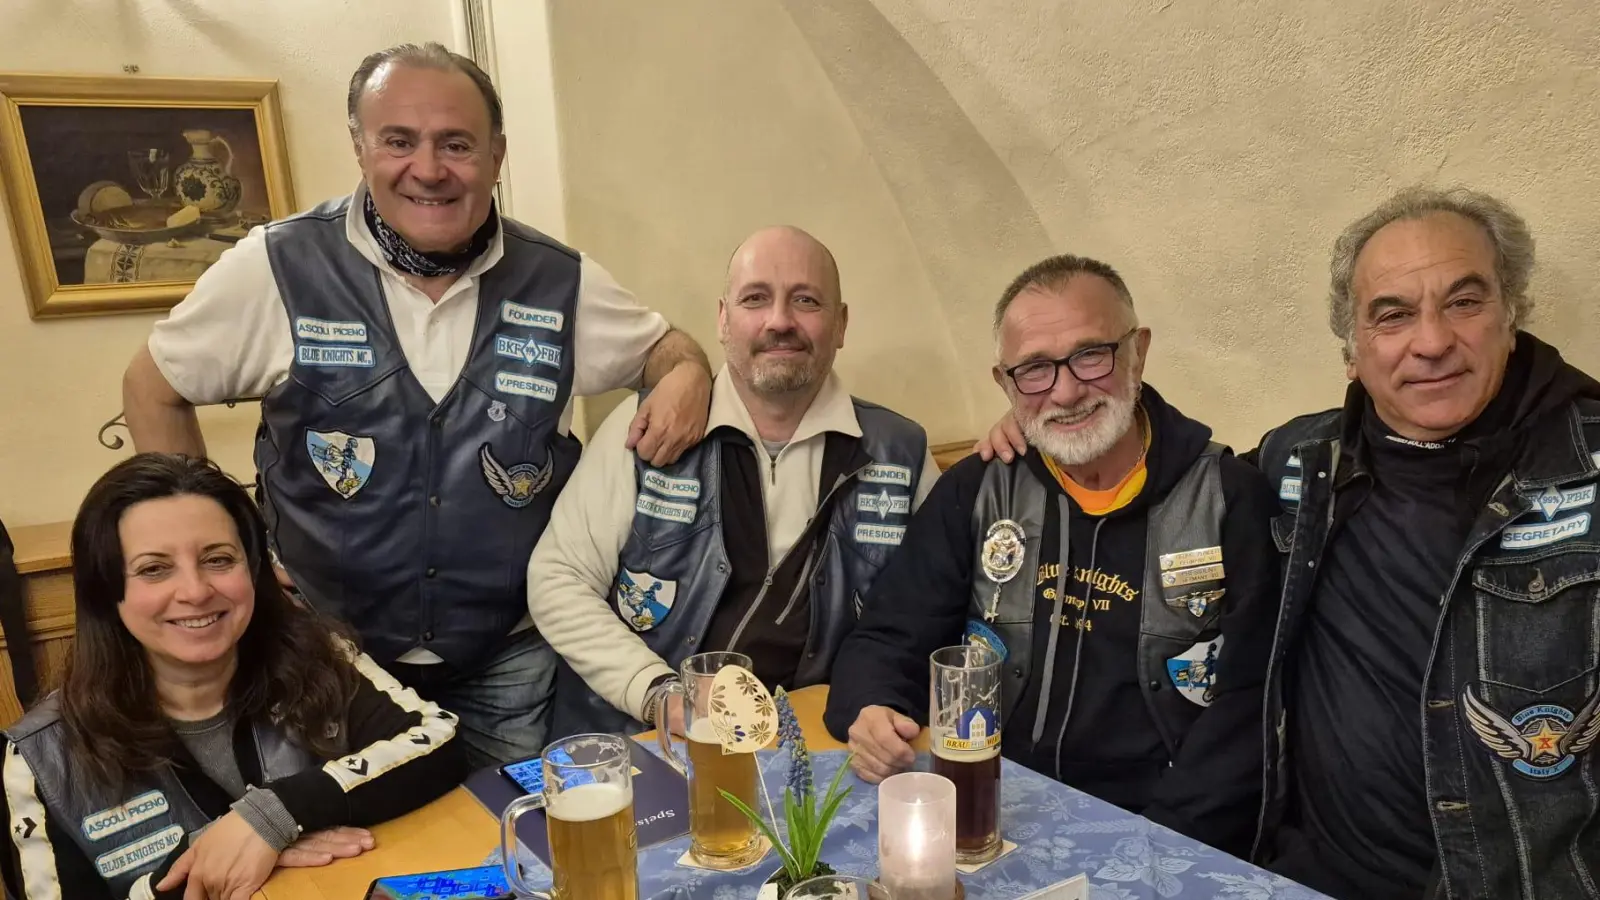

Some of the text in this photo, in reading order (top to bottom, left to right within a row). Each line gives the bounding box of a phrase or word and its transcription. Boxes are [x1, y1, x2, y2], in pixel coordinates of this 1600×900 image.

[508, 308, 557, 326] FOUNDER
[299, 323, 366, 337] ASCOLI PICENO
[302, 347, 320, 361] BLUE
[322, 349, 355, 362] KNIGHTS
[498, 339, 522, 356] BKF
[541, 346, 561, 363] FBK
[499, 377, 557, 396] V.PRESIDENT
[645, 474, 698, 492] ASCOLI PICENO
[864, 468, 907, 481] FOUNDER
[1542, 495, 1559, 504] 99%
[1566, 489, 1591, 503] FBK
[637, 499, 655, 512] BLUE
[654, 503, 681, 517] KNIGHTS
[857, 528, 904, 540] PRESIDEN
[1503, 519, 1585, 542] SEGRETARY
[1037, 562, 1064, 586] Blu
[1092, 599, 1111, 611] VII
[1515, 706, 1570, 723] Blue Knights
[1529, 767, 1550, 775] Italy
[88, 797, 166, 835] ASCOLI PICENO
[635, 809, 676, 826] Speis
[101, 832, 179, 874] BLUE KNIGHTS MC
